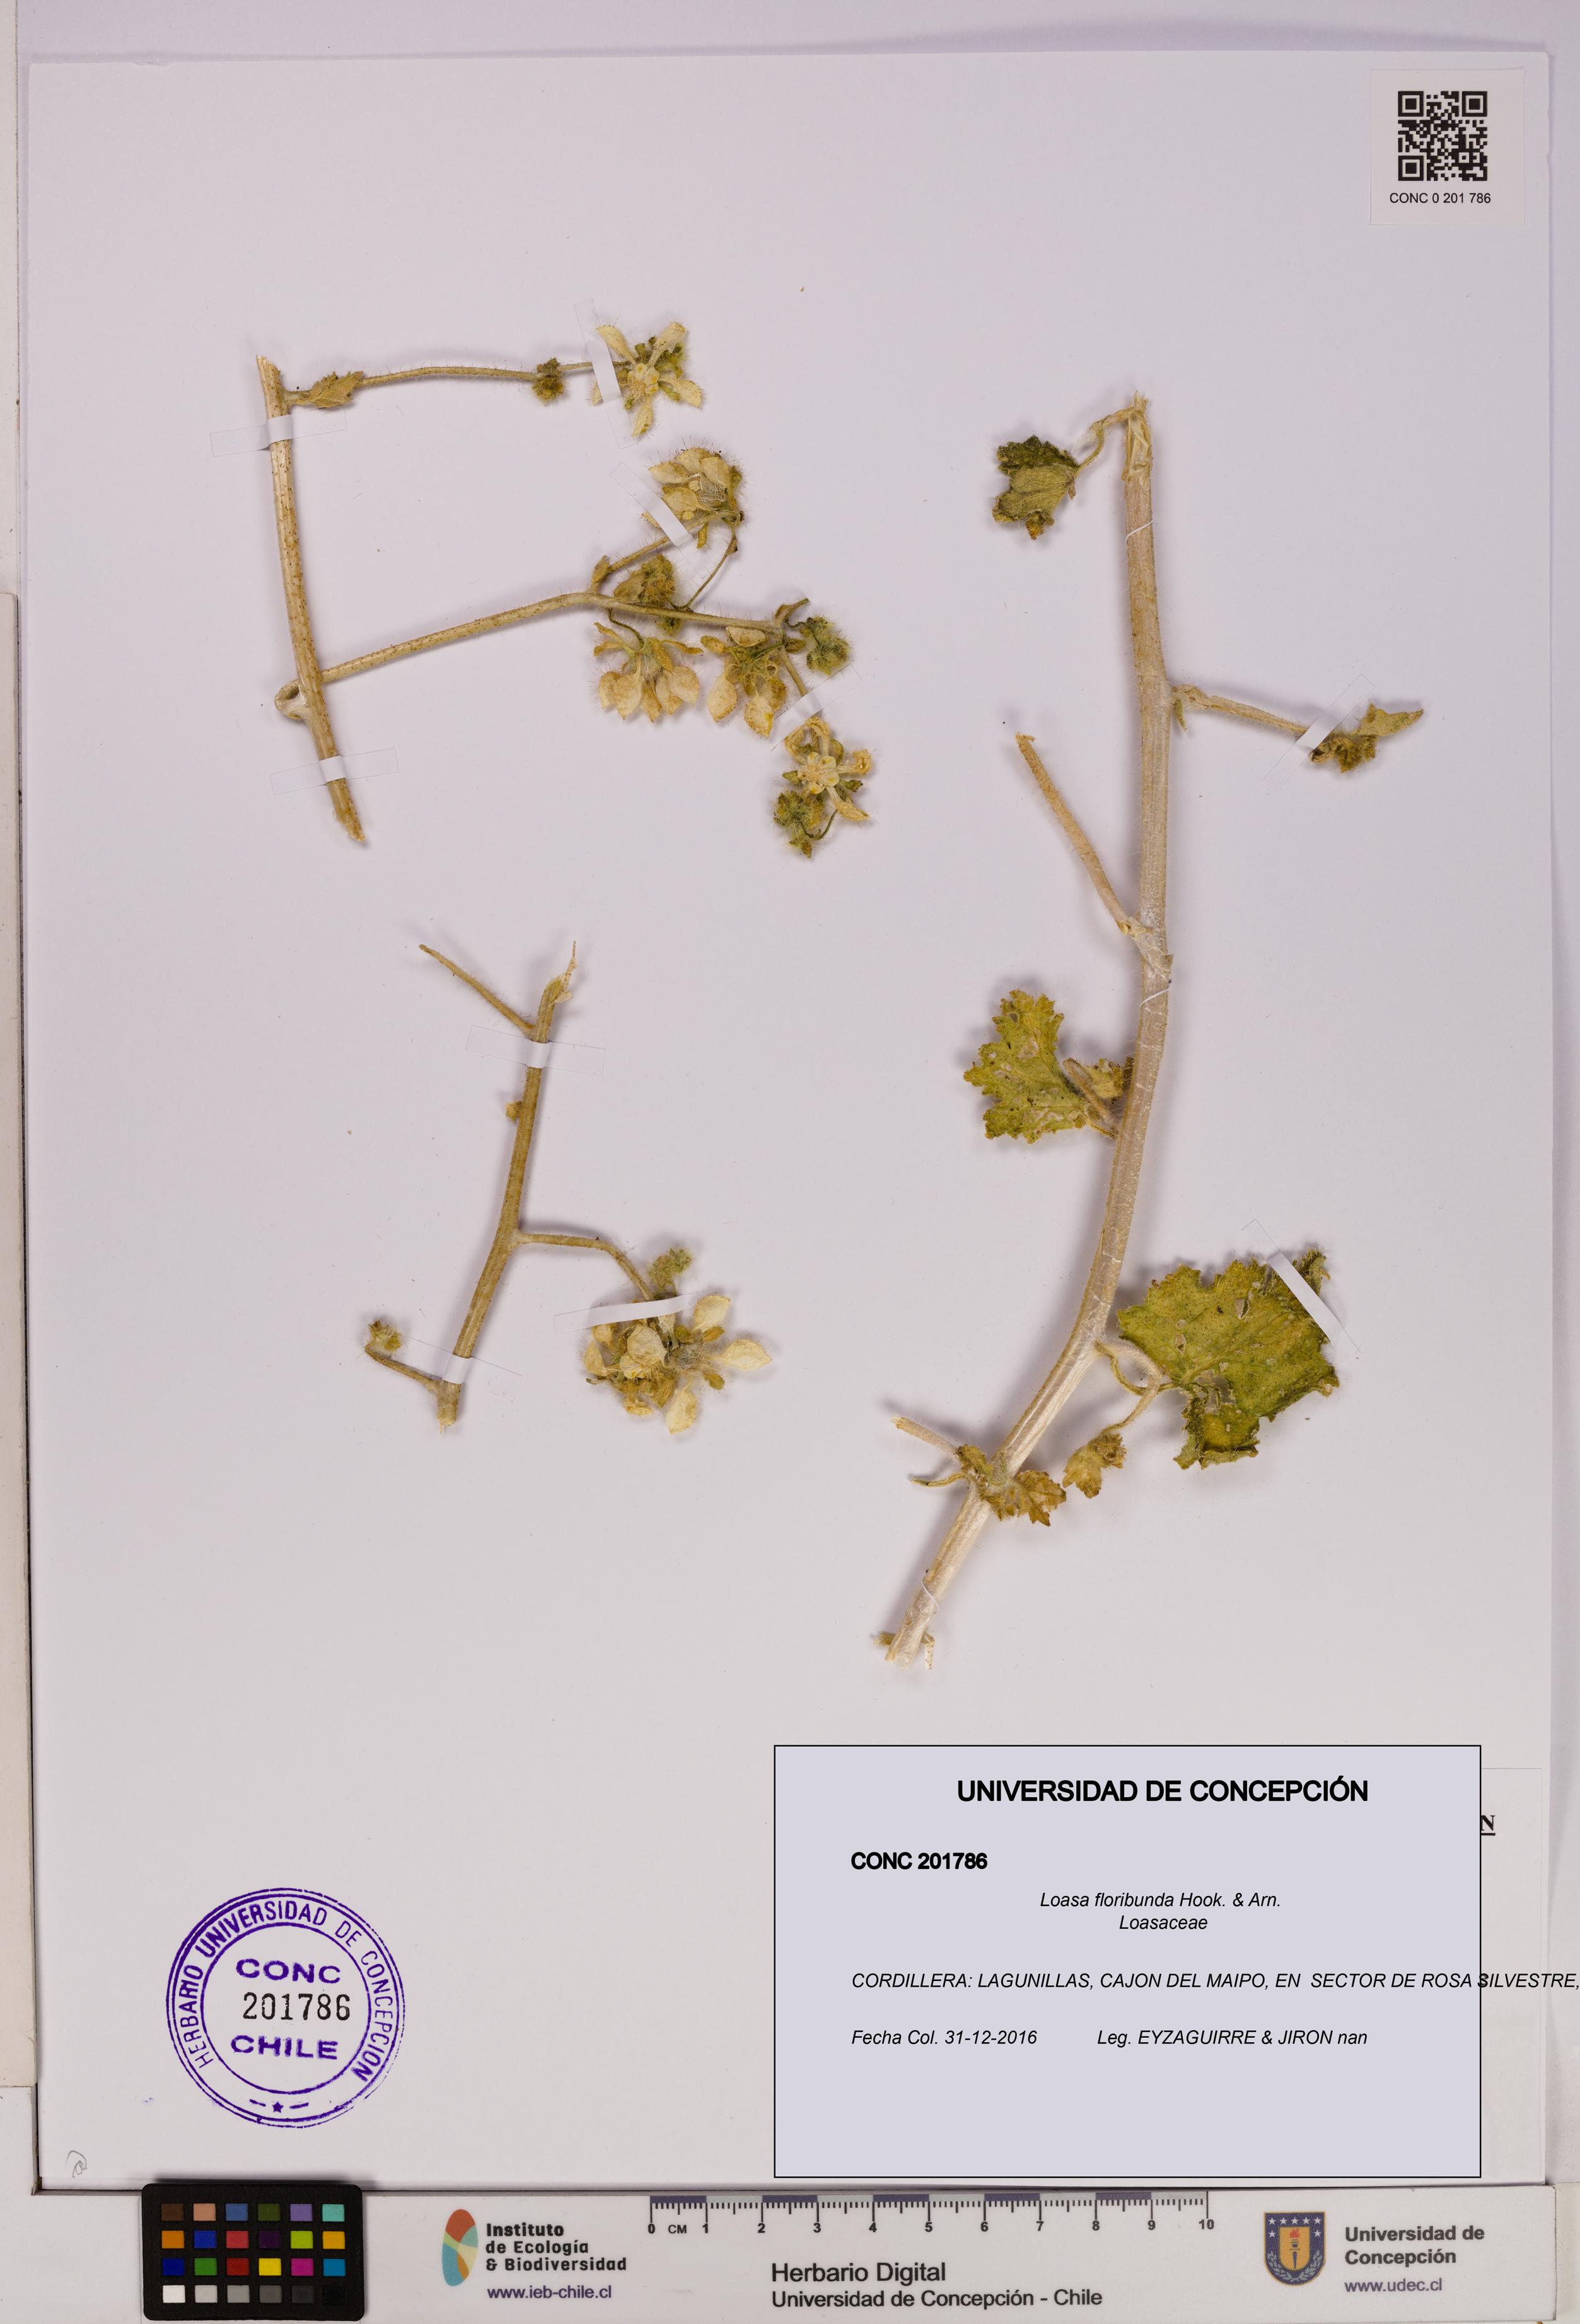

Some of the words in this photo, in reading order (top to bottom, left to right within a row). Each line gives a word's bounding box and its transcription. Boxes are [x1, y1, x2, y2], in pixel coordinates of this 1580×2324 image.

[1390, 192, 1428, 204] CONC
[1432, 192, 1439, 204] 0
[1443, 192, 1464, 204] 201
[1469, 192, 1491, 204] 786
[195, 1900, 328, 1958] UNIVERSIDAD
[334, 1920, 362, 1948] DE
[236, 1958, 341, 1984] CONC
[178, 1964, 213, 2069] HERBARIO
[243, 1992, 351, 2021] 201786
[351, 1950, 393, 2083] CONCEPCION
[231, 2035, 339, 2060] CHILE
[486, 2223, 564, 2237] Instituto
[647, 2223, 656, 2234] 0
[667, 2224, 687, 2234] CM
[702, 2223, 709, 2234] 1
[757, 2223, 766, 2234] 2
[813, 2223, 822, 2234] 3
[868, 2223, 878, 2233] 4
[924, 2222, 933, 2233] 5
[980, 2221, 989, 2233] 6
[1036, 2221, 1044, 2232] 7
[1091, 2221, 1100, 2231] 8
[1147, 2221, 1156, 2231] 9
[1199, 2219, 1216, 2230] 10
[1345, 2225, 1456, 2242] Universidad
[1461, 2224, 1485, 2241] de
[485, 2240, 506, 2254] de
[513, 2239, 588, 2257] Ecología
[1344, 2248, 1456, 2268] Concepción
[485, 2258, 498, 2272] &
[504, 2257, 627, 2272] Biodiversidad
[772, 2262, 869, 2282] Herbario
[876, 2262, 946, 2286] Digital
[487, 2284, 612, 2299] www.ieb-chile.cl
[1344, 2277, 1443, 2293] www.udec.cl
[772, 2290, 885, 2308] Universidad
[890, 2290, 915, 2307] de
[921, 2289, 1034, 2310] Concepción
[1054, 2288, 1103, 2306] Chile
